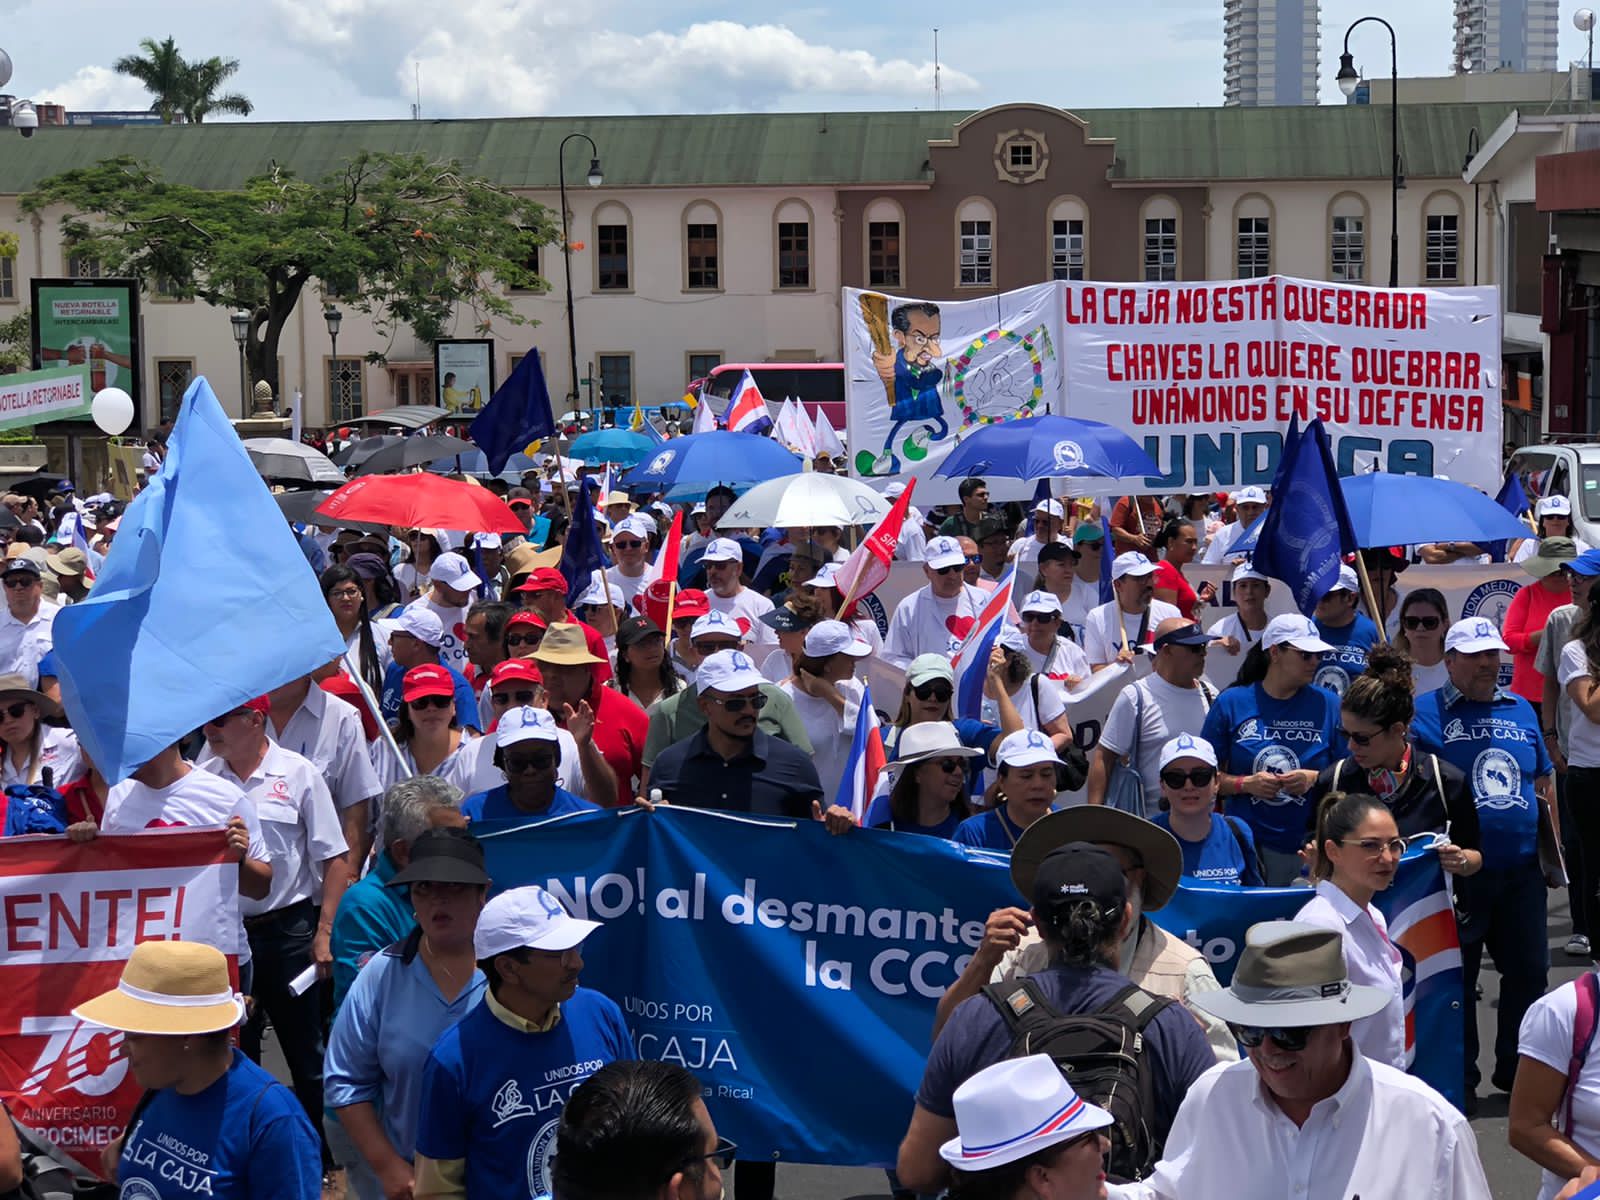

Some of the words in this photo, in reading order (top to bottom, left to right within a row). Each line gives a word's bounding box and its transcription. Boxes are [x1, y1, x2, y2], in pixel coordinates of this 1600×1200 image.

[1065, 287, 1097, 325] LA
[1176, 288, 1208, 324] NO
[1213, 277, 1277, 323] ESTÁ
[1283, 284, 1427, 330] QUEBRADA
[1107, 343, 1203, 381] CHAVES
[1209, 342, 1240, 380] LA
[1351, 346, 1481, 390] QUEBRAR
[33, 383, 80, 405] RETORNABLE
[1132, 382, 1267, 425] UNÁMONOS
[1275, 385, 1308, 422] EN
[1316, 386, 1350, 424] SU
[1358, 388, 1484, 432] DEFENSA
[1144, 431, 1434, 488] UNDCA
[1481, 580, 1521, 598] MEDIC
[1263, 730, 1282, 740] LA
[1285, 730, 1322, 743] CAJA
[1471, 728, 1491, 739] LA
[1493, 728, 1529, 743] CAJA
[655, 872, 706, 921] al
[4, 886, 186, 951] ENTE!
[804, 940, 852, 991] la
[674, 1003, 713, 1023] POR
[544, 1063, 585, 1082] UNIDOS
[534, 1088, 565, 1111] LA
[717, 1085, 754, 1100] Rica!
[22, 1105, 117, 1121] ANIVERSARIO
[157, 1132, 189, 1158] UNIDOS
[186, 1147, 209, 1165] POR
[133, 1144, 156, 1170] LA
[160, 1158, 214, 1197] CAJA
